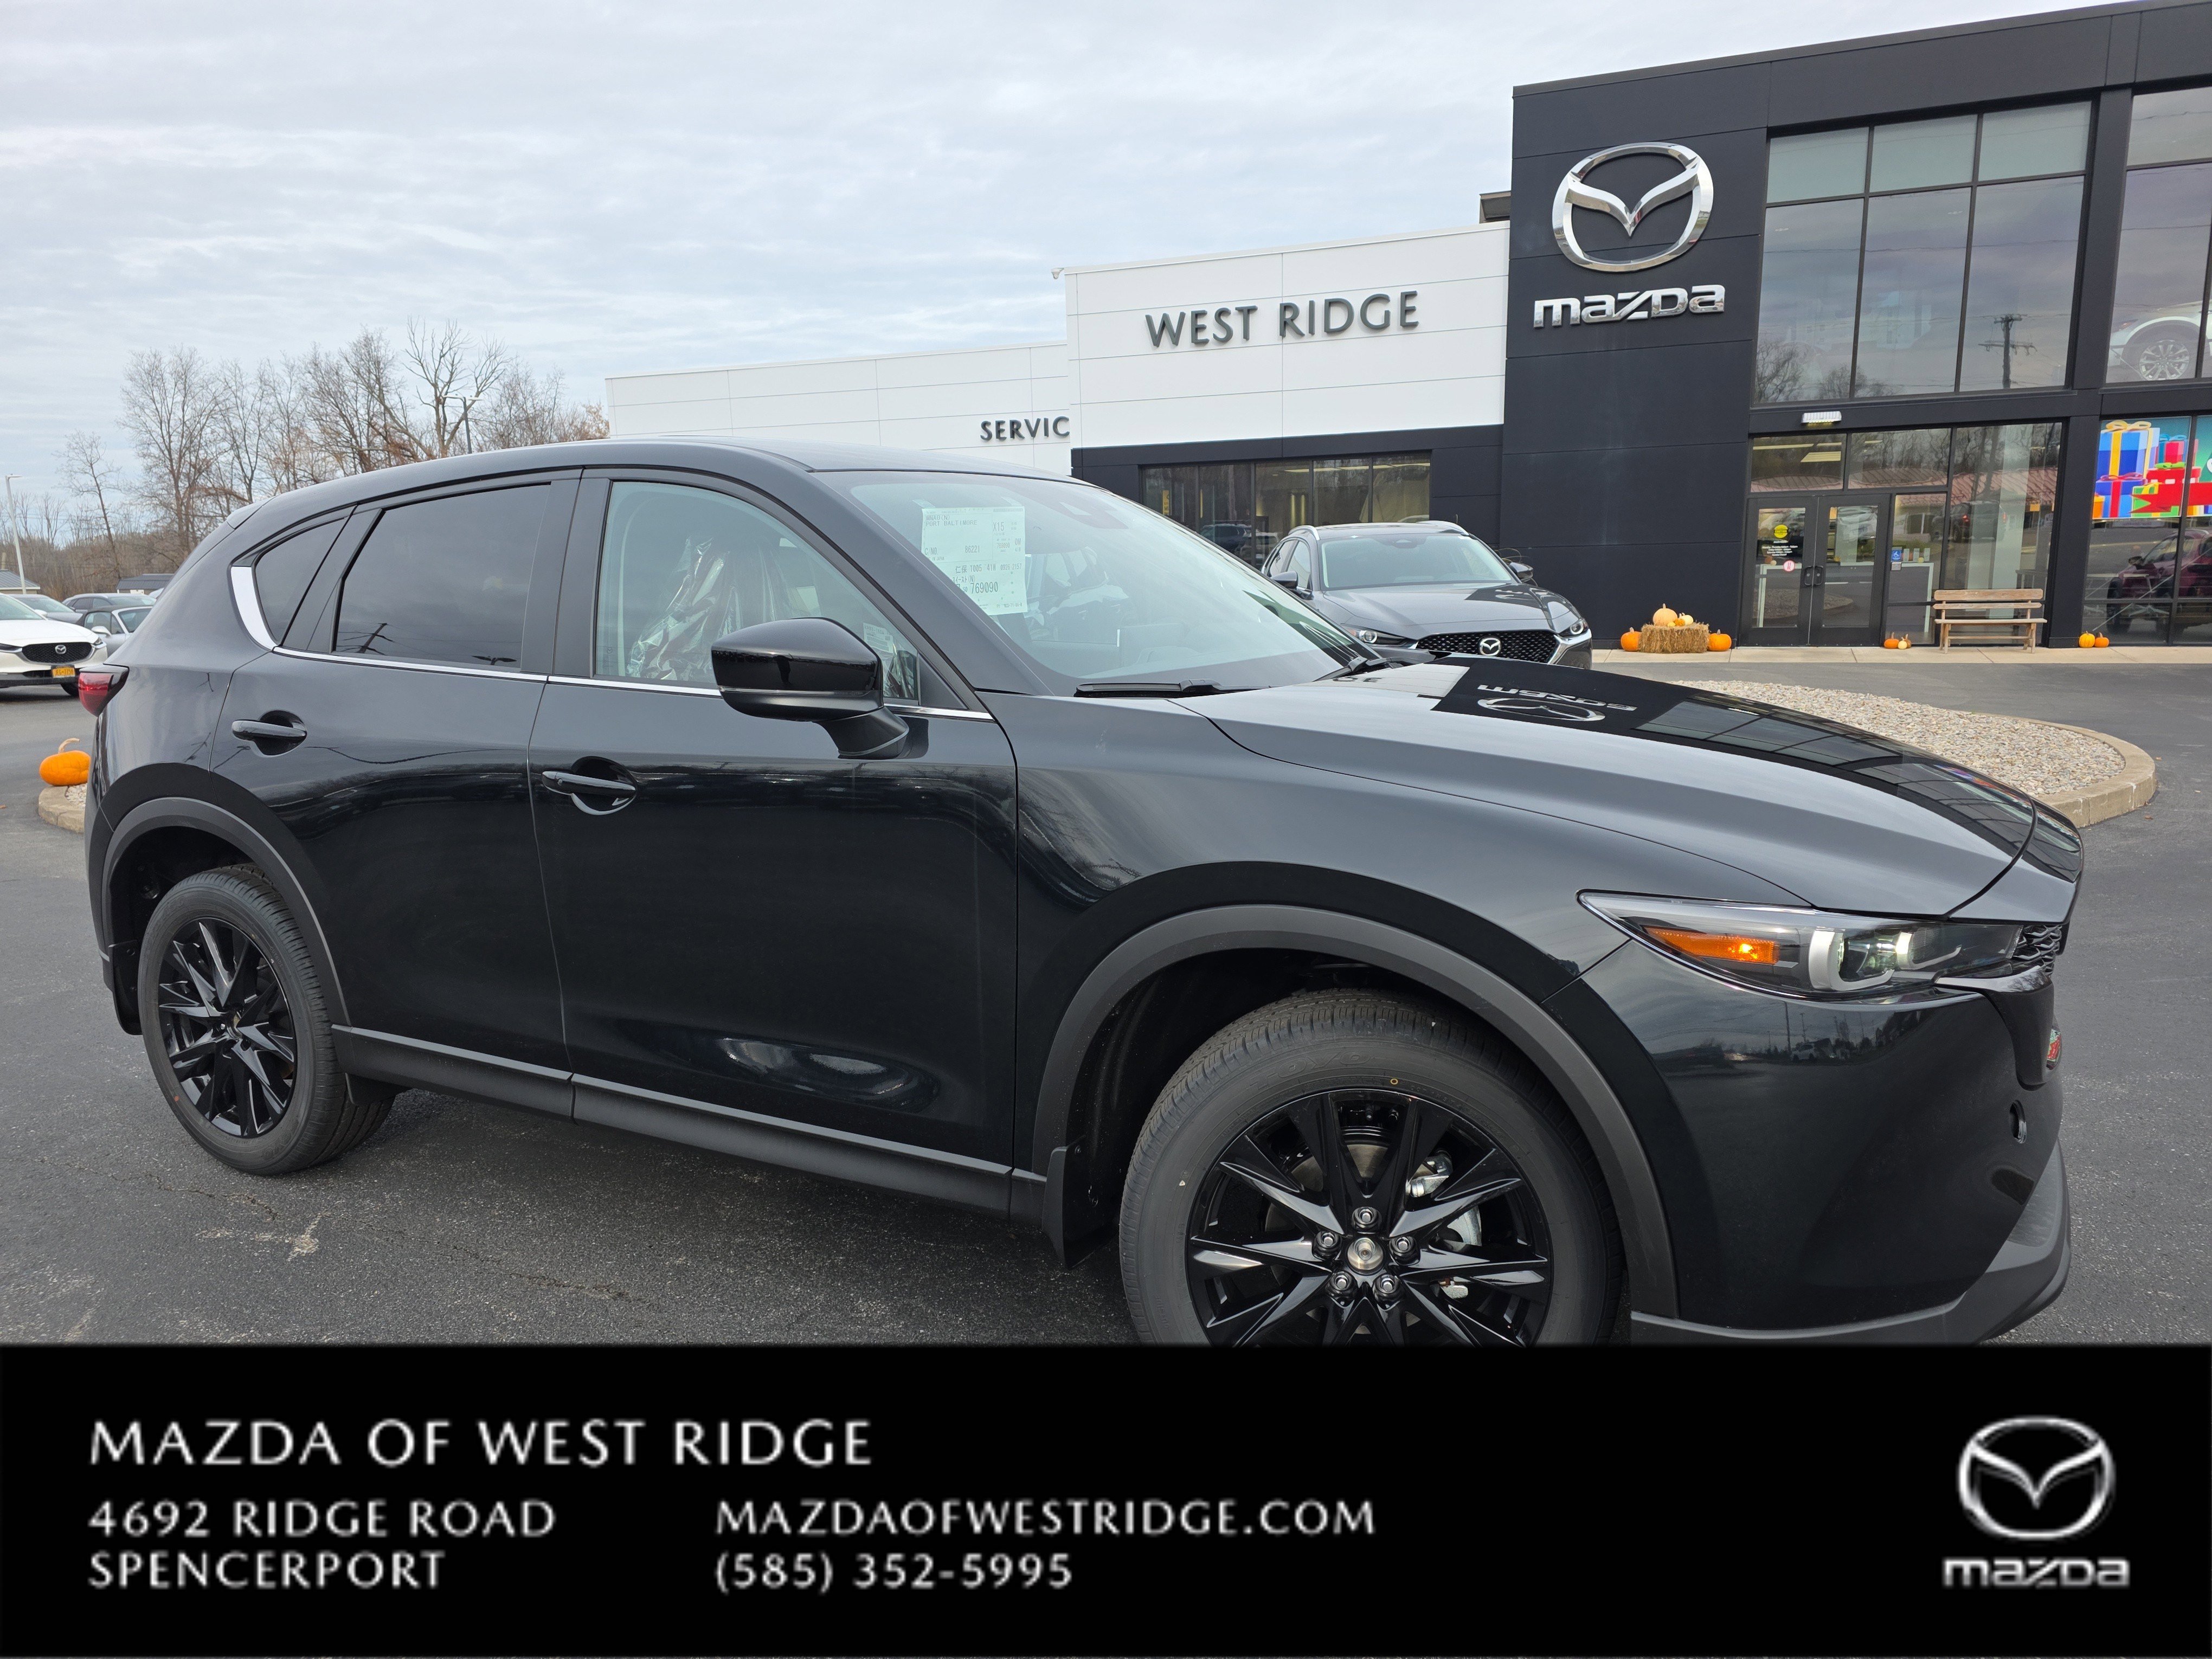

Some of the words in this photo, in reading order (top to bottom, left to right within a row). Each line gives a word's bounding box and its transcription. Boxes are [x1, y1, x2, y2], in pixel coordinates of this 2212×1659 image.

[1144, 305, 1258, 348] WEST
[1279, 290, 1419, 337] RIDGE
[1533, 284, 1725, 329] mazda
[993, 522, 1005, 532] X15
[970, 581, 998, 594] 769090
